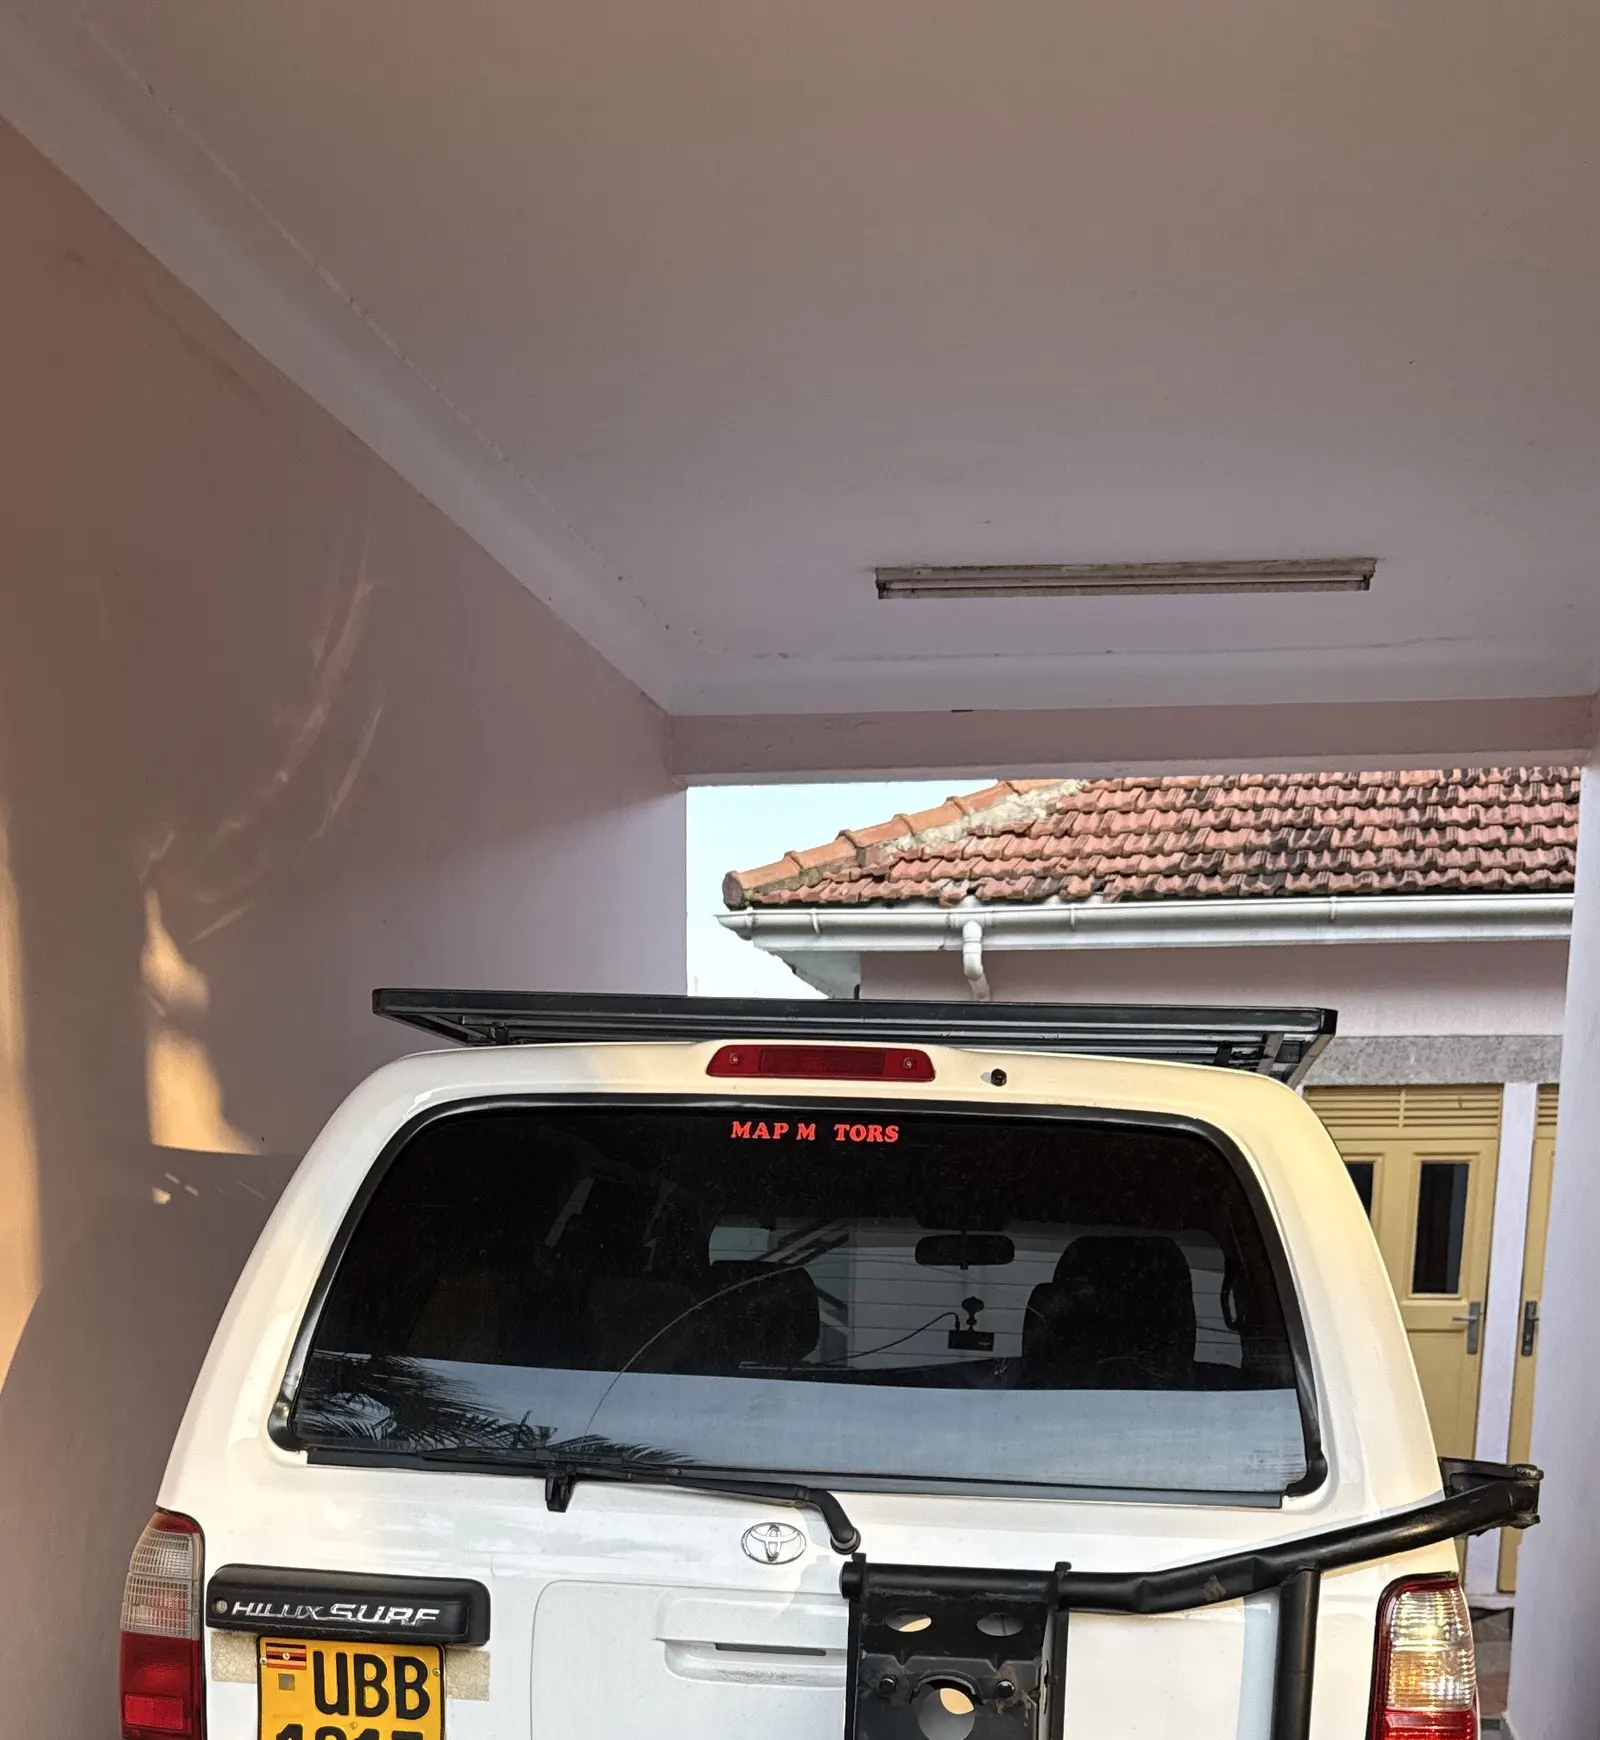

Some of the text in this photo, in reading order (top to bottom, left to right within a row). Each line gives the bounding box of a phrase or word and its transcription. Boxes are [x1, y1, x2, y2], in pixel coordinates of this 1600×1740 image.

[730, 1121, 789, 1140] MAP
[231, 1601, 440, 1626] HILUX SURF
[313, 1650, 430, 1720] UBB
